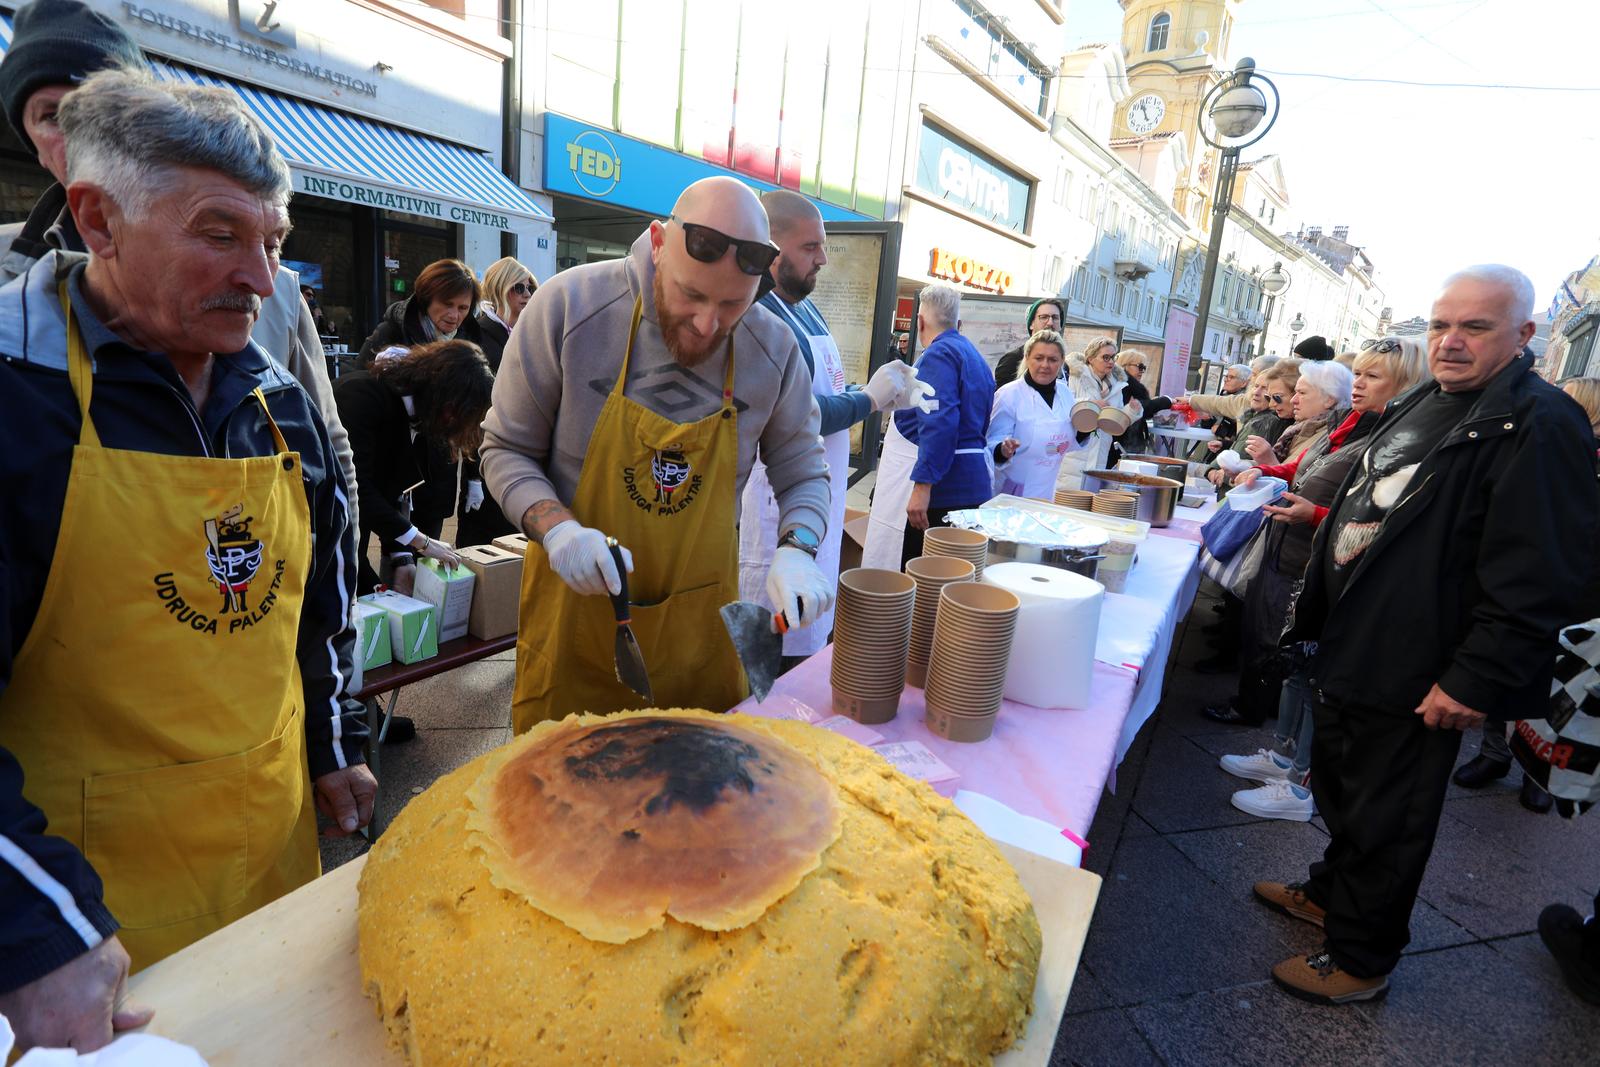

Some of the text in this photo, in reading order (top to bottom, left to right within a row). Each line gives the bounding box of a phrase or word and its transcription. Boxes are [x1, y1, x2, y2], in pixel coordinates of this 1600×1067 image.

[121, 1, 377, 98] TOURIST INFORMATION
[303, 175, 510, 230] INFORMATIVNI CENTAR
[938, 147, 1009, 220] CENTRA
[927, 246, 1013, 294] KORZO
[623, 467, 702, 516] UDRUGA PALENTAR
[154, 559, 285, 635] UDRUGA PALENTAR
